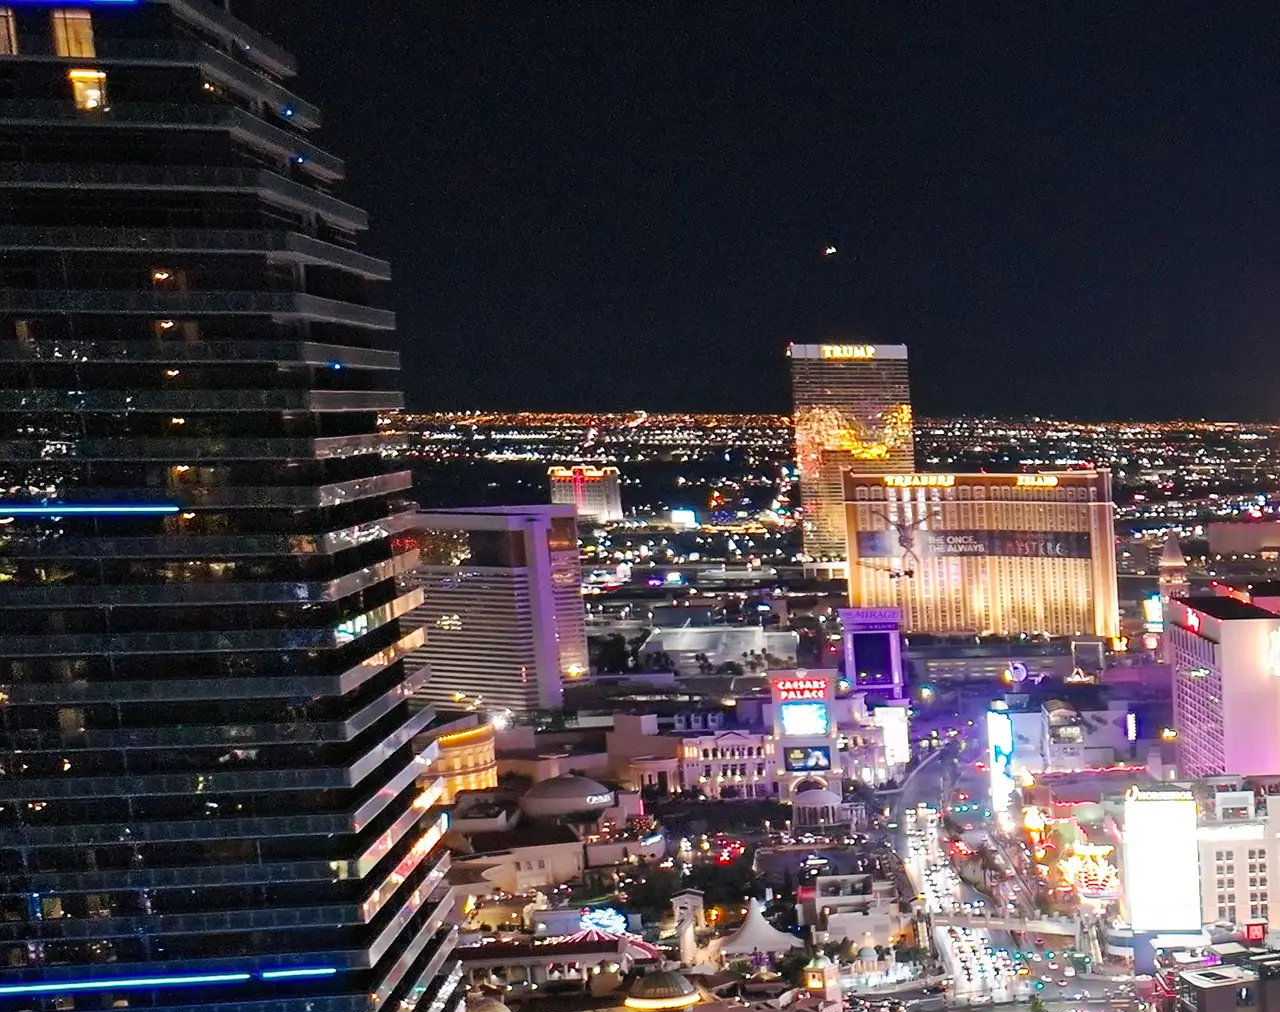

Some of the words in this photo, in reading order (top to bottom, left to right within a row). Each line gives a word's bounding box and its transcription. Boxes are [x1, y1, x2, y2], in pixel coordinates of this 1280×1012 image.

[822, 344, 876, 358] TRUMP
[884, 475, 956, 487] TREASURE
[1016, 475, 1059, 487] ISLAND
[929, 544, 946, 553] THE
[947, 544, 985, 553] ALWAYS
[777, 680, 826, 690] CAESARS
[781, 690, 825, 700] PALACE
